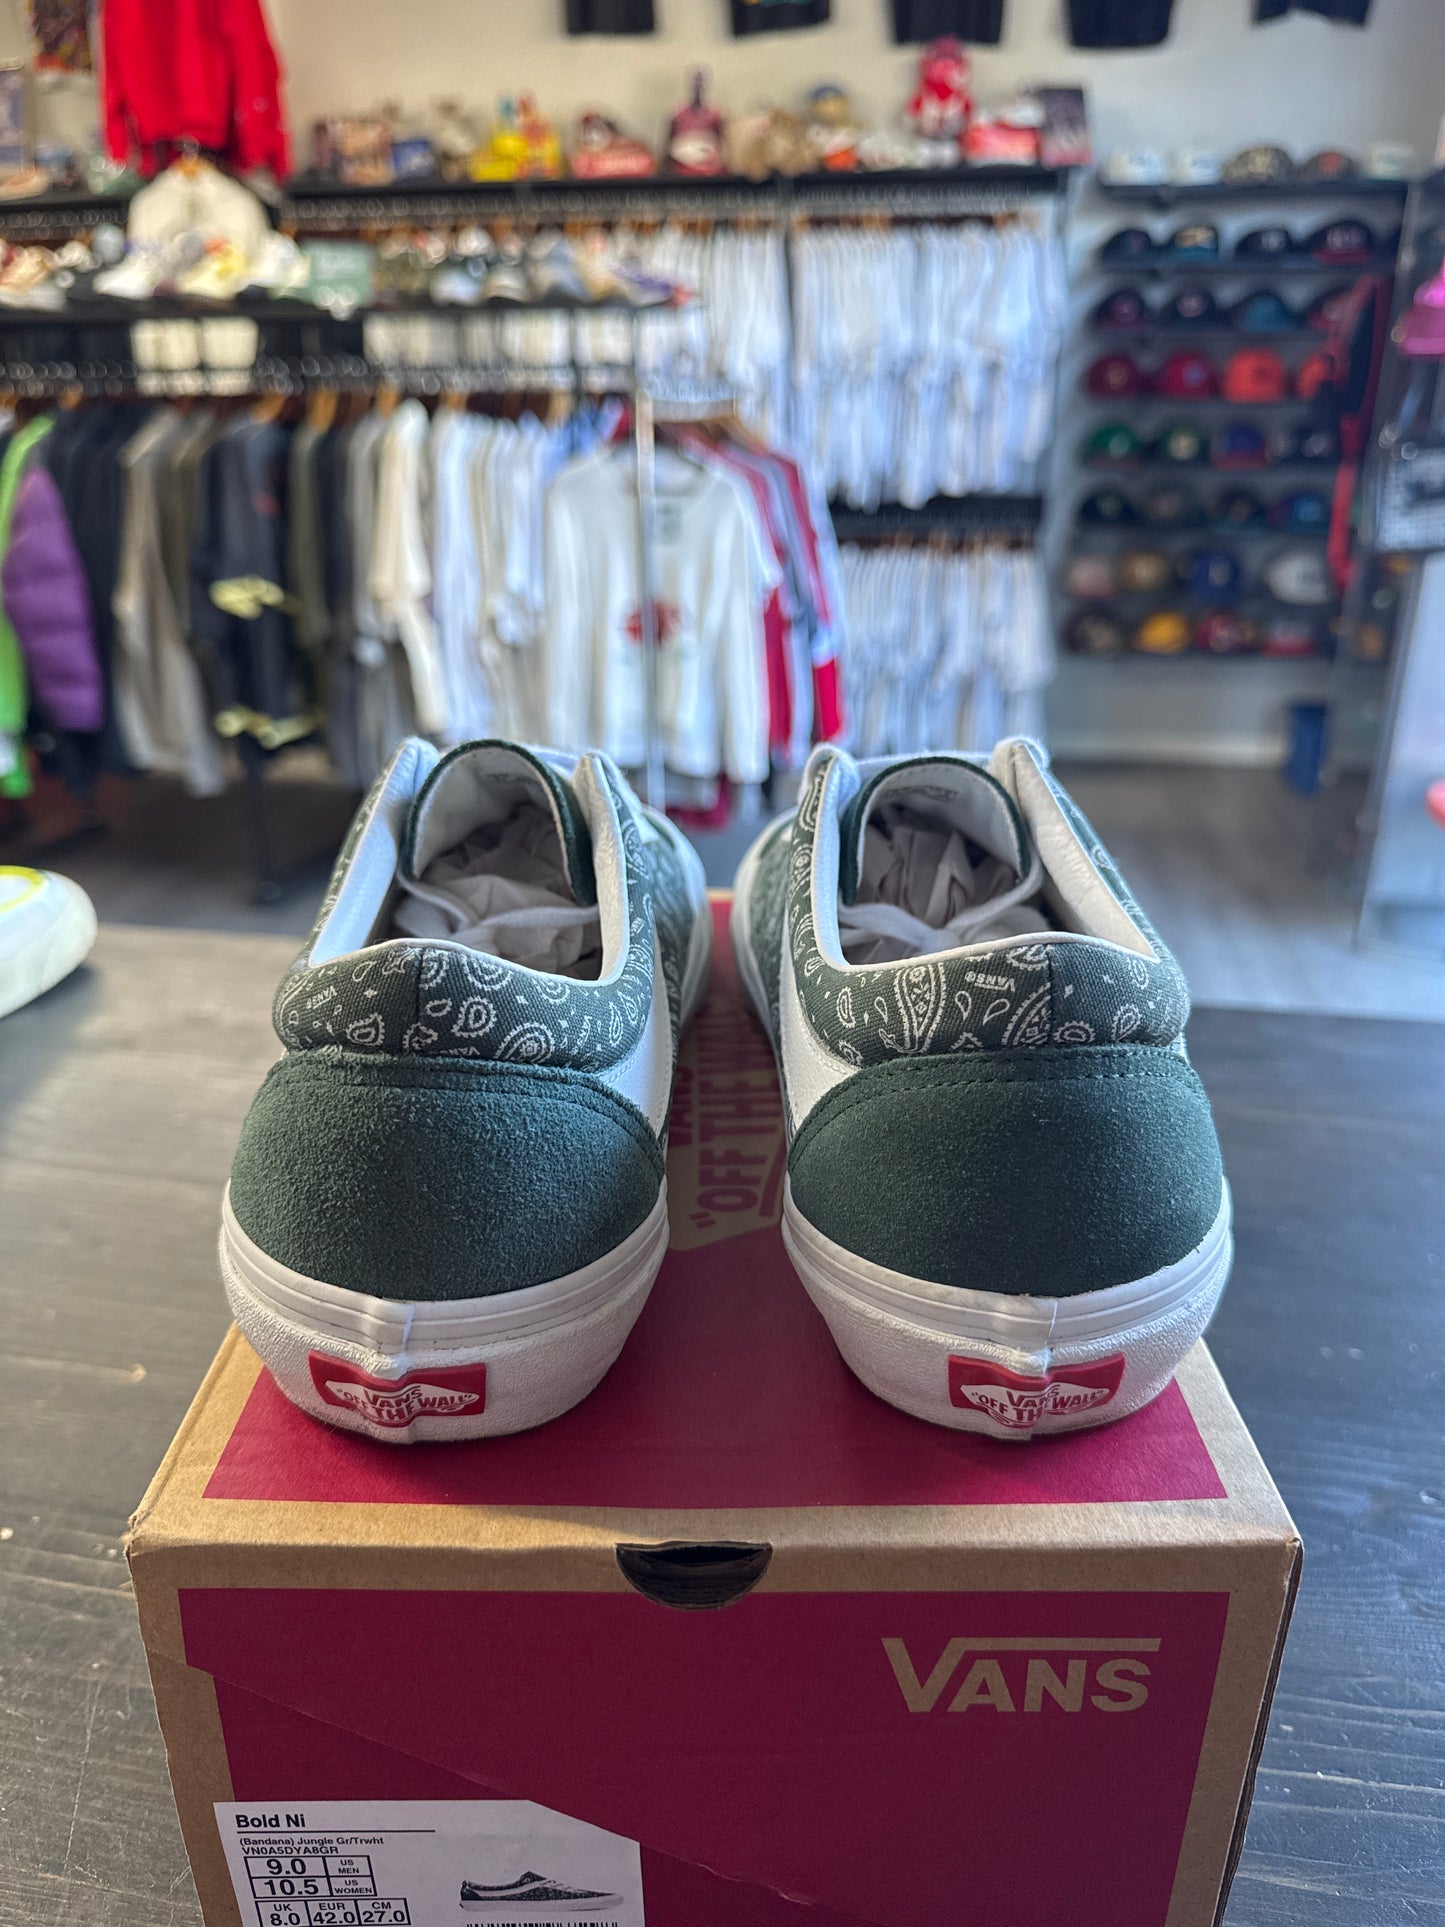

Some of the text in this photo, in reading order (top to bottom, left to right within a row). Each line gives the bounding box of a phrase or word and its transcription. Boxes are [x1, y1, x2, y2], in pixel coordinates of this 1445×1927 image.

[363, 1385, 423, 1408] VANS
[375, 1399, 417, 1420] THE
[880, 1637, 1162, 1713] VANS
[235, 1813, 306, 1828] Bold Ni
[239, 1836, 385, 1846] (Bandana) Jungle Gr/Trwht
[266, 1858, 307, 1875] 9.0
[338, 1866, 360, 1875] MEN
[264, 1878, 319, 1896] 10.5
[334, 1887, 373, 1895] WOMEN
[273, 1901, 392, 1912] UK EUR CM
[270, 1910, 406, 1927] 8.0 42.0 27.0
